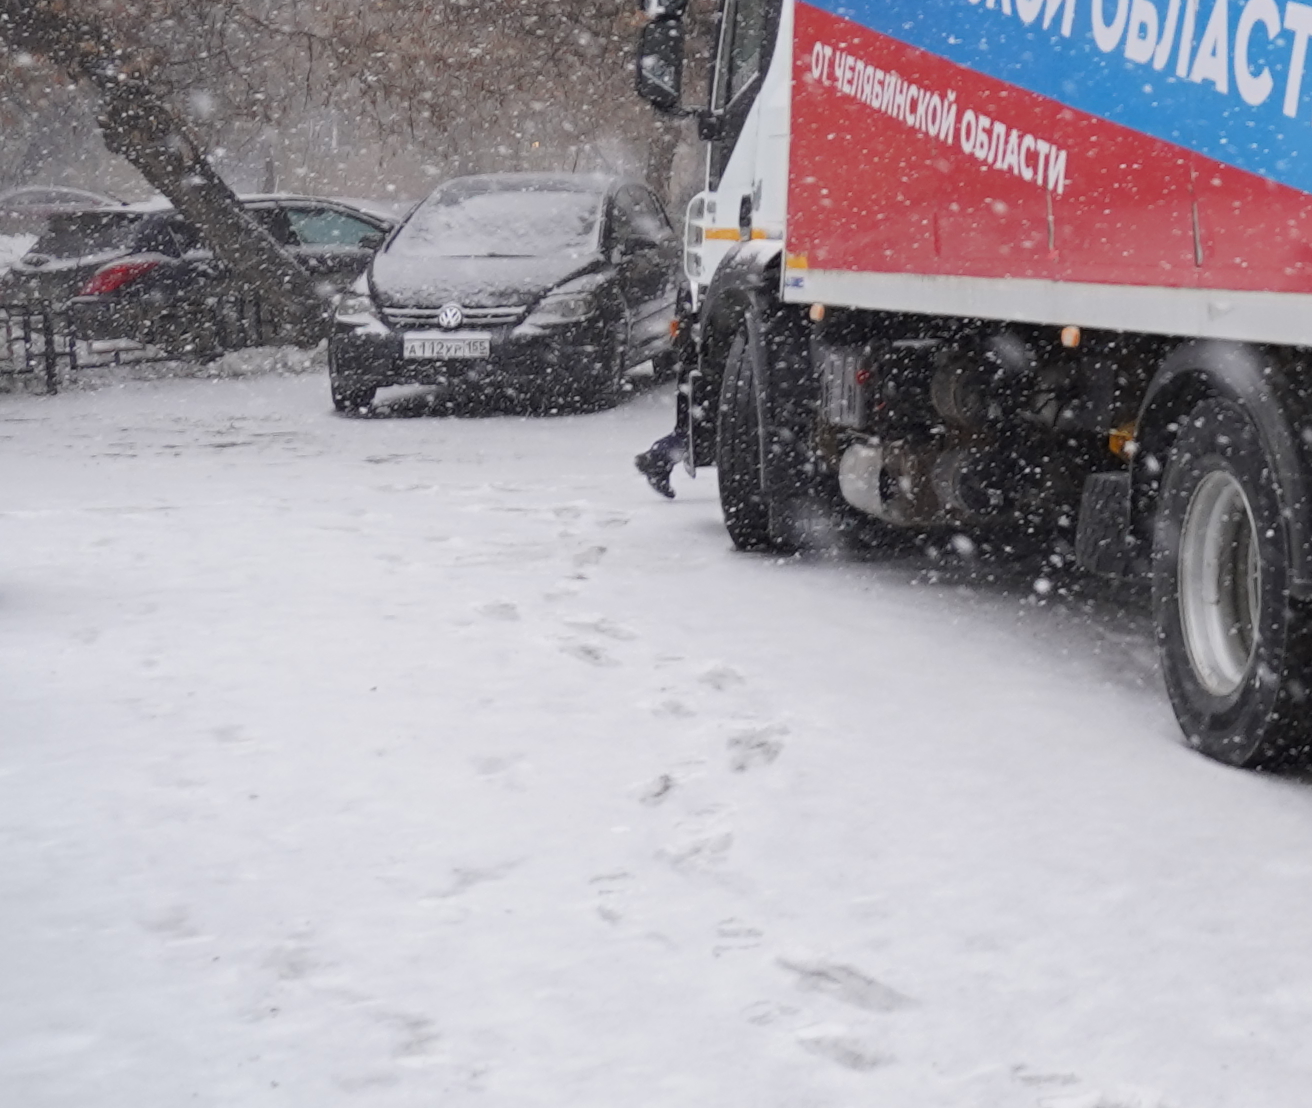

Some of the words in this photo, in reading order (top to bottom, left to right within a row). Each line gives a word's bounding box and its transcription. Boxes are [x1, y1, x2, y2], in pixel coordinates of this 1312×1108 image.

[811, 41, 833, 83] ОТ
[834, 50, 957, 146] ЧЕЛЯБИНСКОЙ
[960, 108, 1068, 196] ОБЛАСТИ
